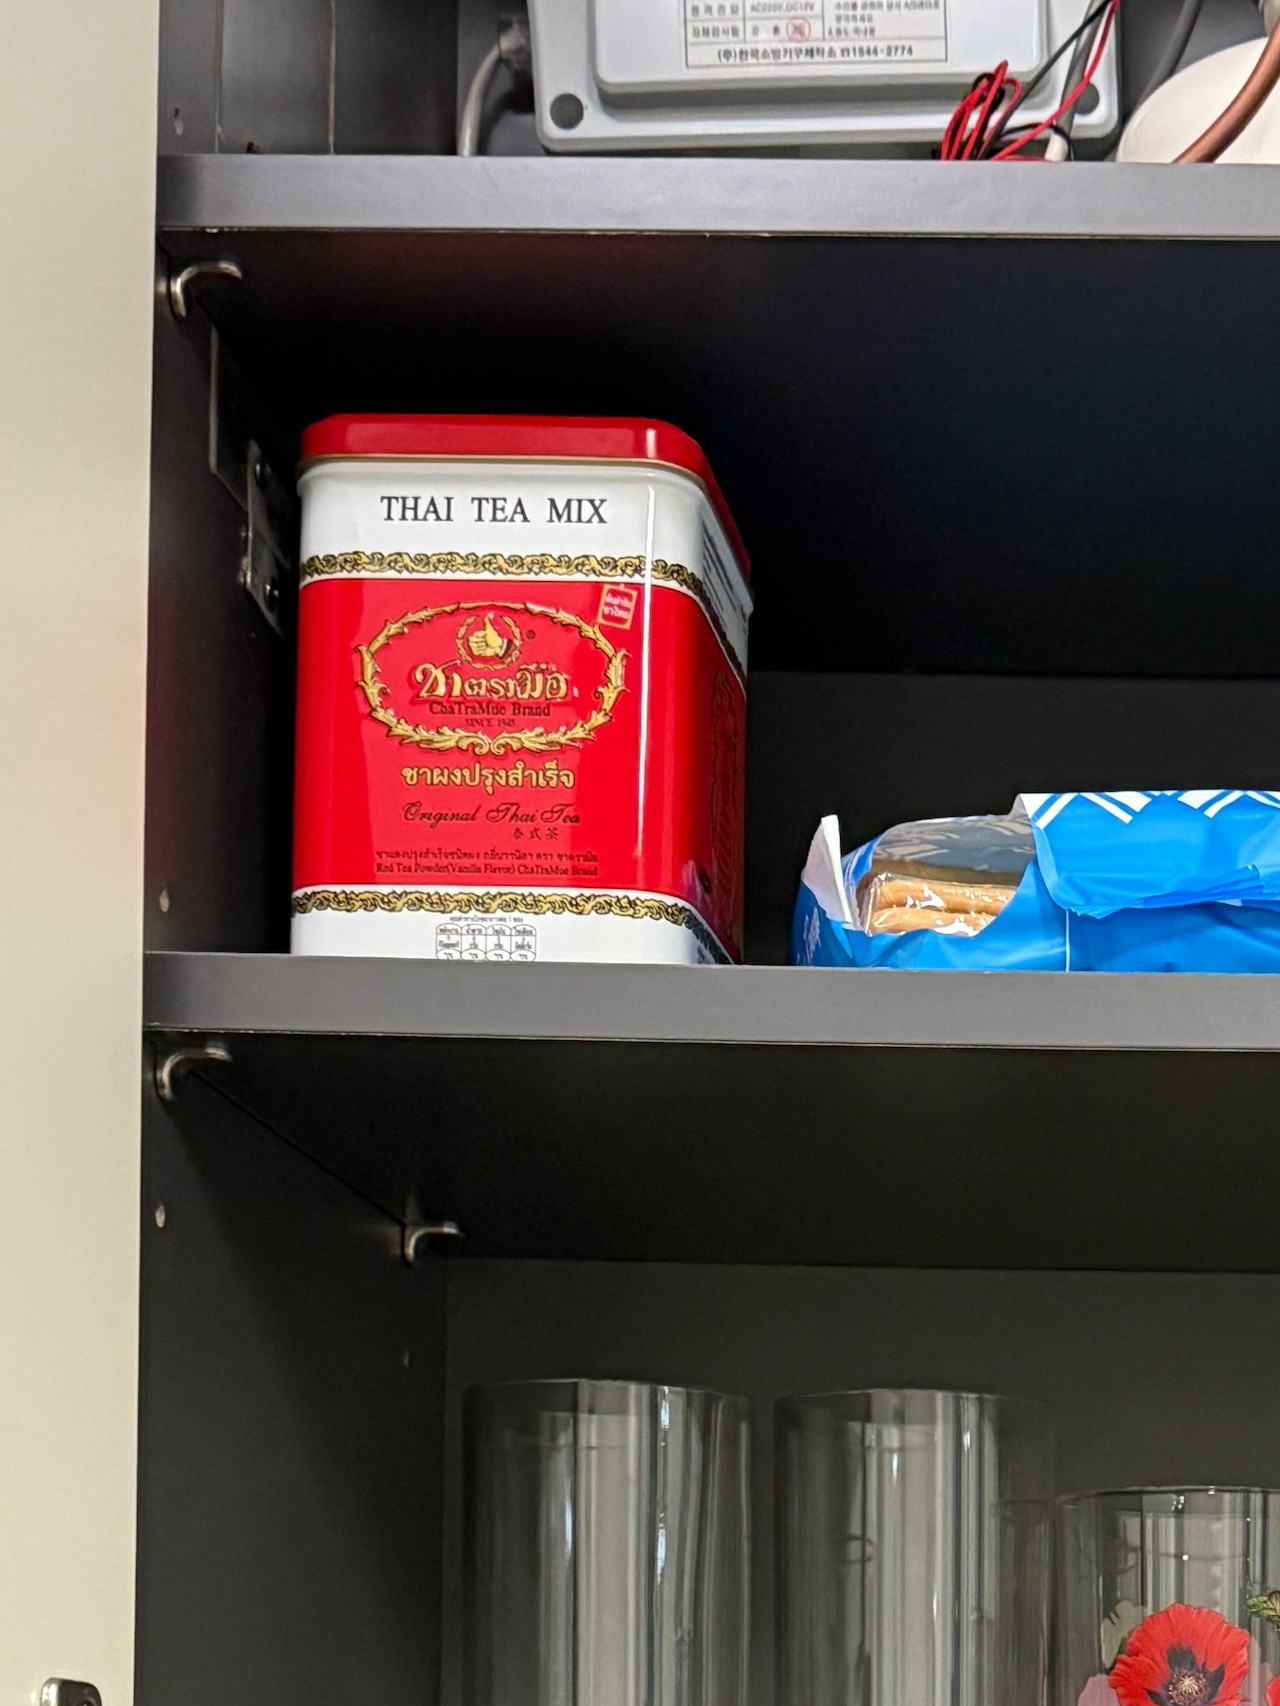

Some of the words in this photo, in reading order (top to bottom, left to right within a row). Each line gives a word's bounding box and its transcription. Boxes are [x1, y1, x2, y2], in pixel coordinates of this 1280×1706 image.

[380, 496, 454, 522] THAI
[471, 497, 531, 523] TEA
[546, 498, 608, 524] MIX
[428, 701, 506, 717] ChaTraMue
[511, 702, 551, 717] Brand
[401, 758, 576, 796] ชาผงปรุงสำเร็จ
[402, 801, 482, 829] Original
[486, 802, 537, 824] Thai
[540, 803, 581, 824] Tea
[376, 862, 394, 873] Red
[396, 863, 412, 873] Tea
